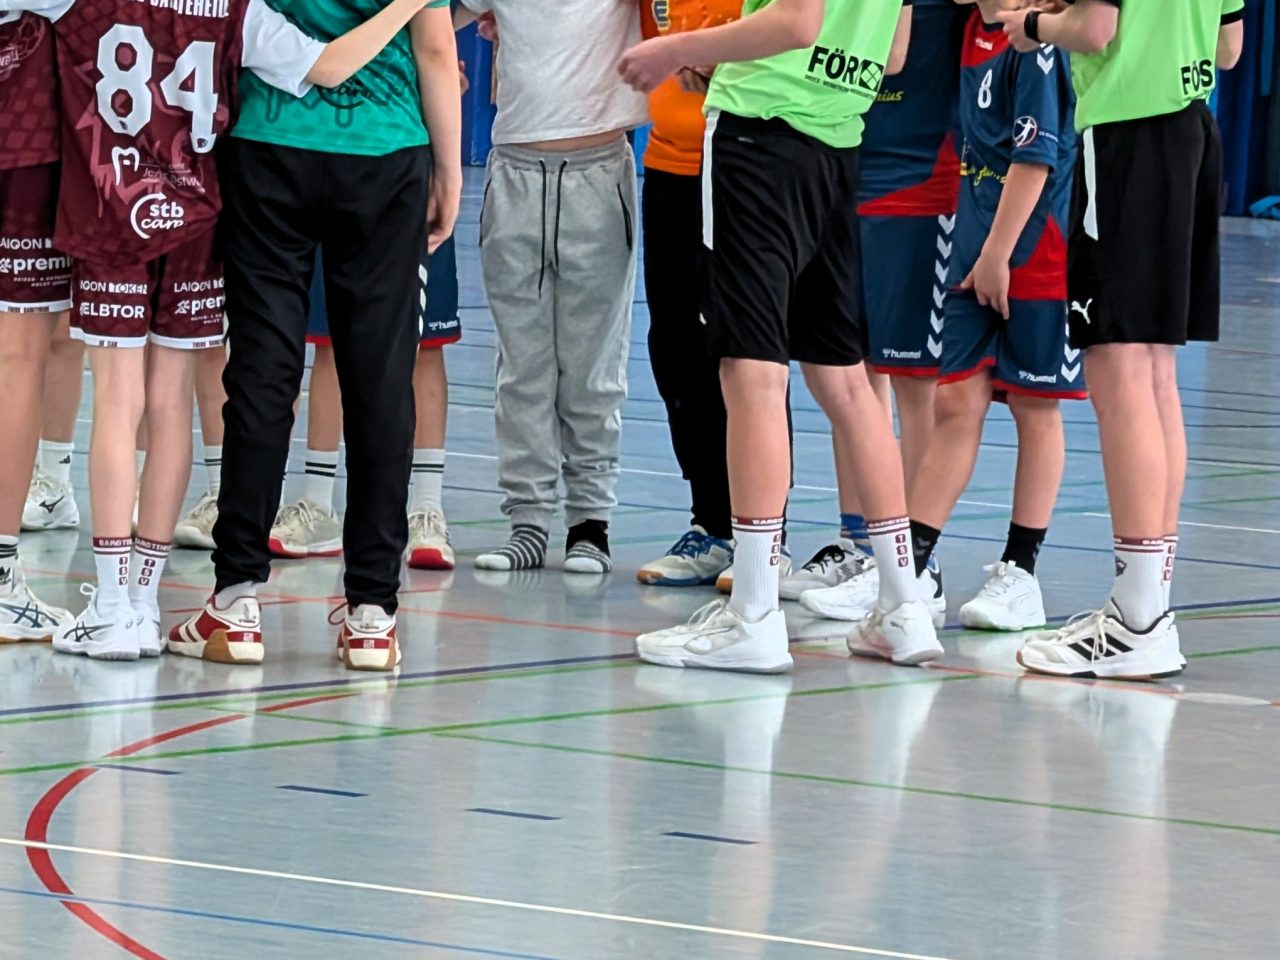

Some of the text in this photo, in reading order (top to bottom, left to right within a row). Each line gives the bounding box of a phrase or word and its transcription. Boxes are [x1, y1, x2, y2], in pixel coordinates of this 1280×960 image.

[96, 24, 218, 153] 84
[150, 201, 184, 219] stb
[174, 278, 211, 293] LAIQON
[81, 301, 145, 318] ELBTOR
[895, 534, 909, 567] TSV
[138, 558, 156, 586] TSV
